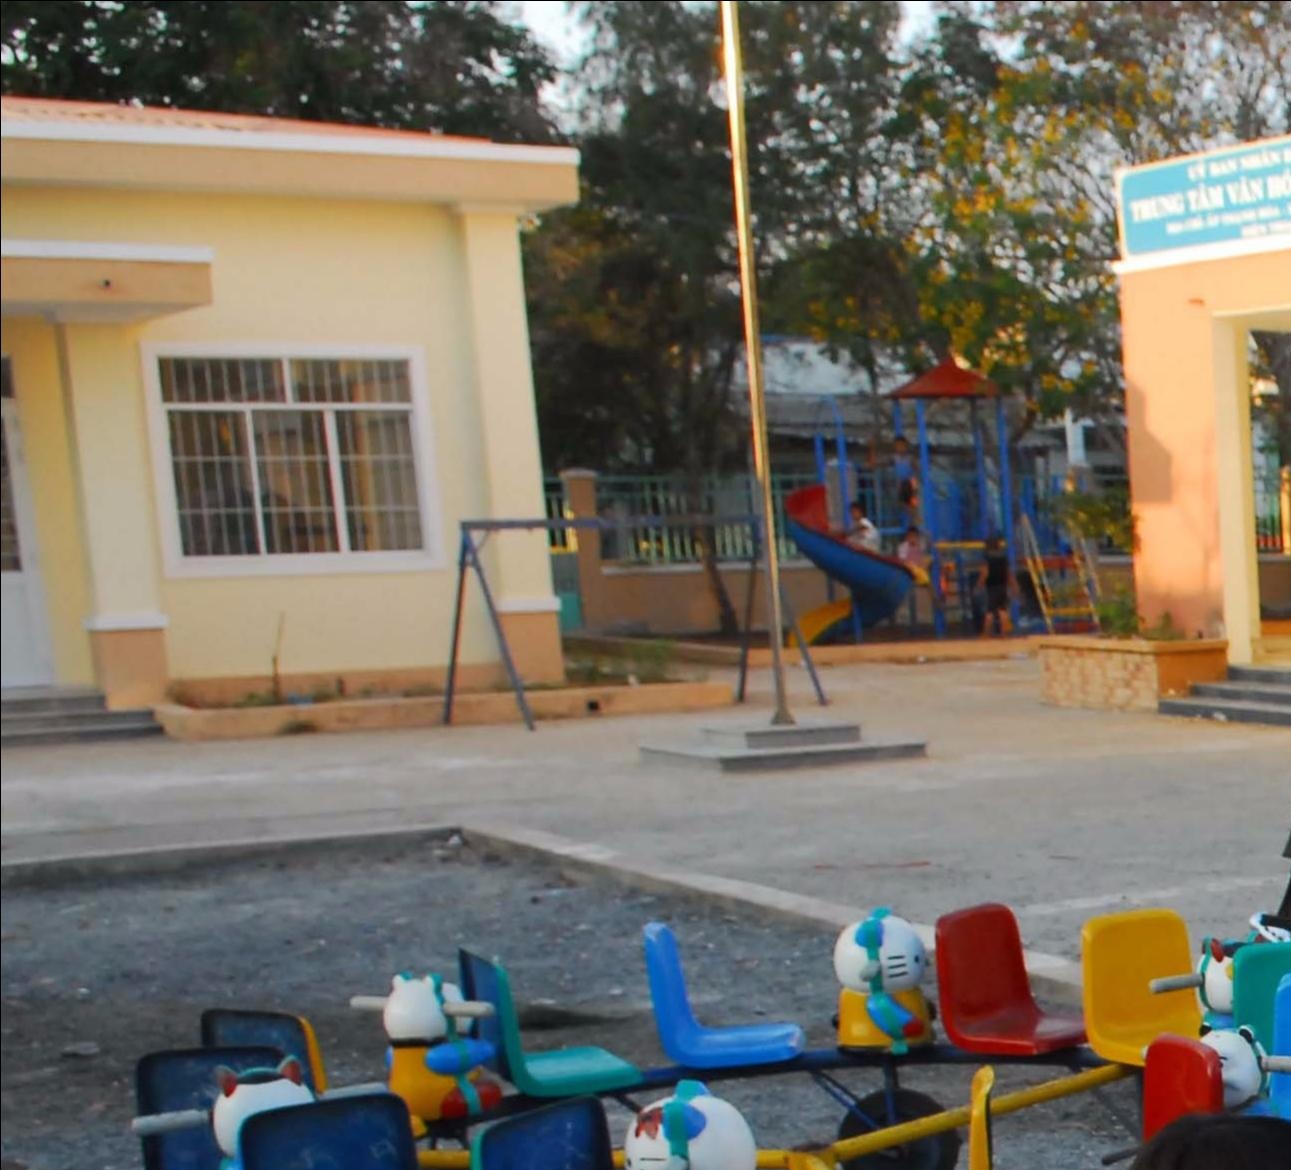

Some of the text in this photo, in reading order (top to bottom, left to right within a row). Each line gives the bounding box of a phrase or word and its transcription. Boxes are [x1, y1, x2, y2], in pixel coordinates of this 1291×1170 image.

[1208, 158, 1238, 177] BAN
[1129, 192, 1185, 223] TRUNG
[1186, 182, 1225, 212] TÂM
